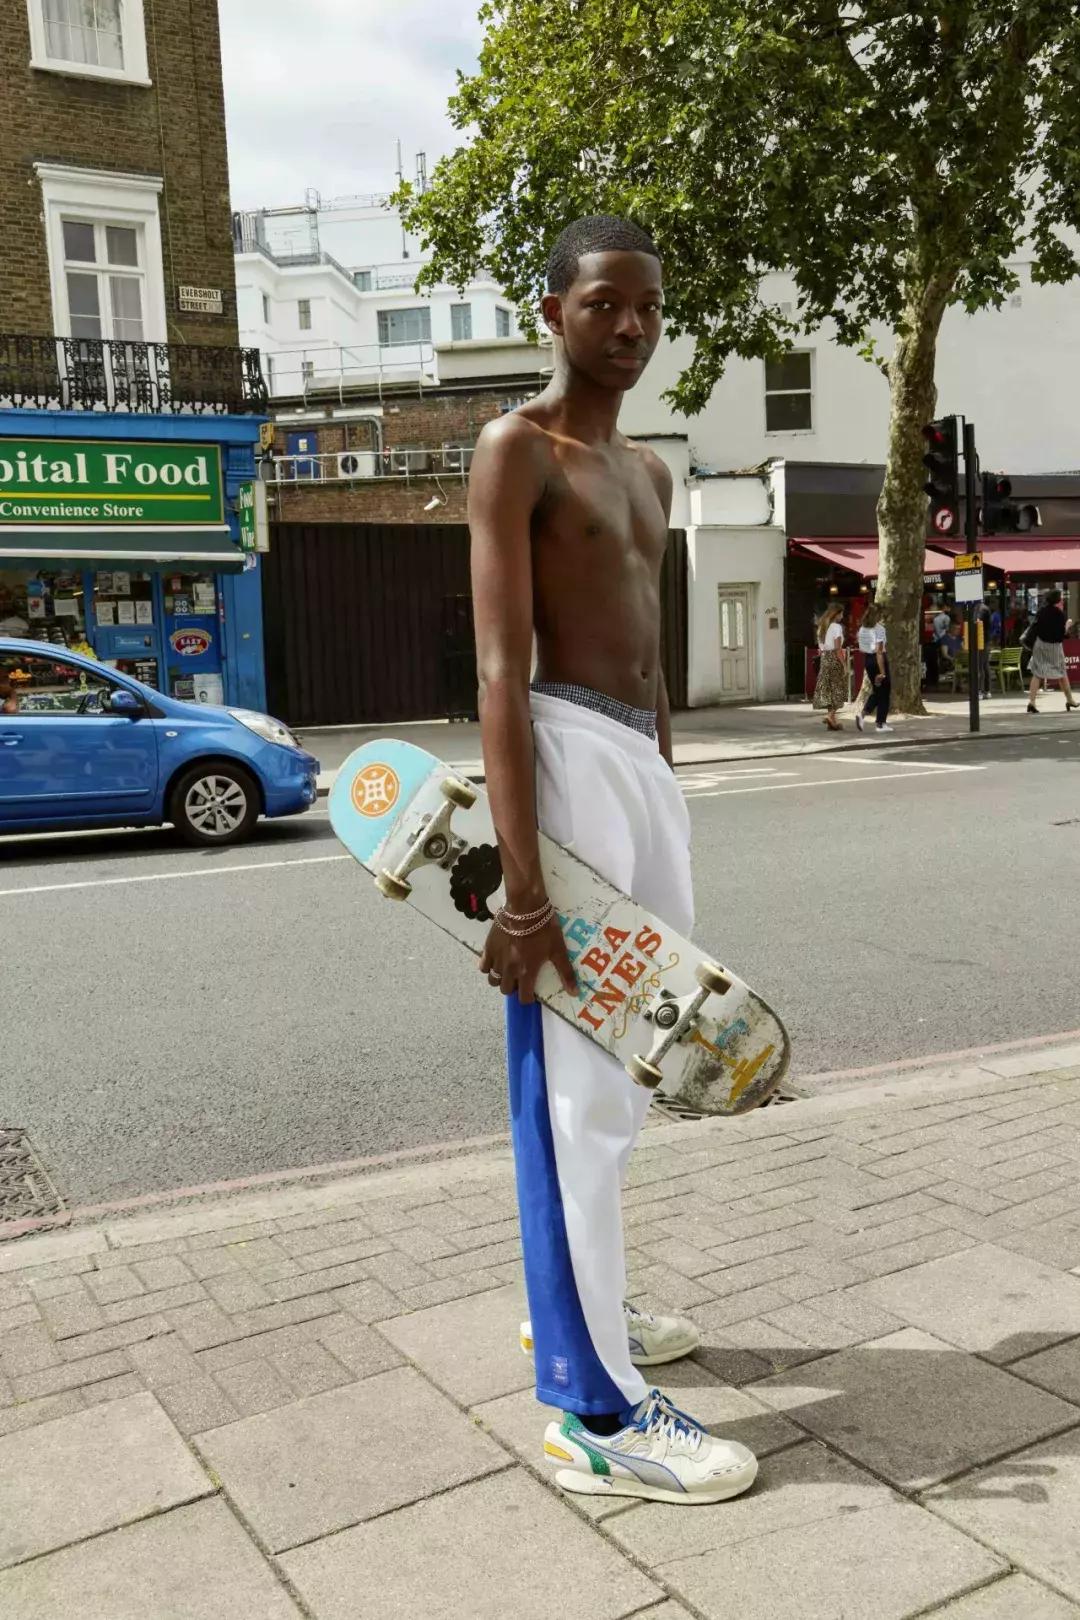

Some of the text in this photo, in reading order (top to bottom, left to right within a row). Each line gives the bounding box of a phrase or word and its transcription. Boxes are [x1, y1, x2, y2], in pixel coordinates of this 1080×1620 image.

[180, 288, 219, 299] EVERSHOLT
[181, 301, 208, 310] STREET
[102, 453, 210, 485] Food
[0, 502, 144, 517] Convenience Store
[1064, 656, 1080, 664] OSTA
[577, 925, 662, 1031] INES
